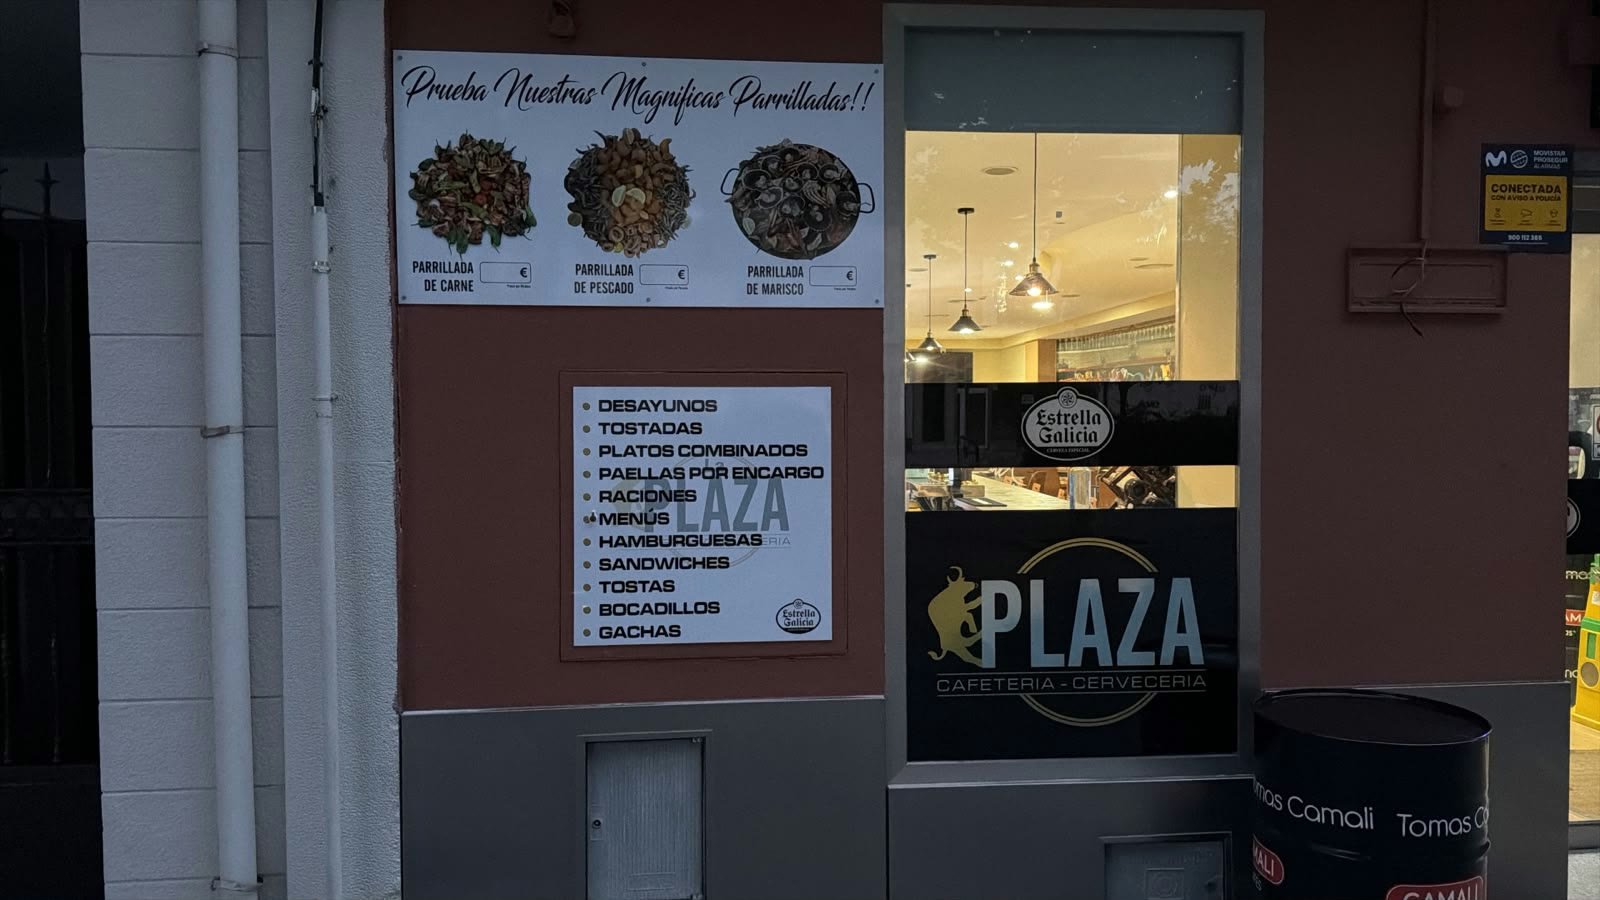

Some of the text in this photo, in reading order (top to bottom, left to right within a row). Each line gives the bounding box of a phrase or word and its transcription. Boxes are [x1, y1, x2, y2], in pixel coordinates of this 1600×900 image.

[401, 65, 875, 126] Prueba Nuestras Magnificas Parrilladas!!
[1491, 183, 1561, 194] CONECTADA
[412, 261, 474, 274] PARRILLADA
[575, 263, 634, 277] PARRILLADA
[747, 266, 804, 278] PARRILLADA
[424, 279, 474, 292] DE CARNE
[574, 281, 634, 294] DE PESCADO
[746, 283, 804, 295] DE MARISCO
[598, 399, 718, 412] DESAYUNOS
[1036, 408, 1101, 426] Estrella
[598, 422, 703, 435] TOSTADAS
[1039, 426, 1098, 444] Galicia
[599, 444, 808, 458] PLATOS COMBINADOS
[599, 466, 824, 480] PAELLAS POR ENCARGO
[599, 489, 697, 502] RACIONES
[644, 477, 789, 532] PLAZA
[599, 508, 670, 525] MENÚS
[599, 533, 762, 548] HAMBURGUESAS
[599, 556, 730, 571] SANDWICHES
[598, 580, 675, 593] TOSTAS
[599, 601, 720, 616] BOCADILLOS
[782, 609, 815, 618] Estrella
[783, 617, 814, 627] Galicia
[980, 576, 1205, 669] PLAZA
[599, 624, 681, 639] GACHAS
[936, 676, 1055, 692] CAFETERIA
[1072, 674, 1207, 690] CERVECERIA
[1287, 795, 1375, 830] Camali
[1396, 813, 1472, 837] Tomas
